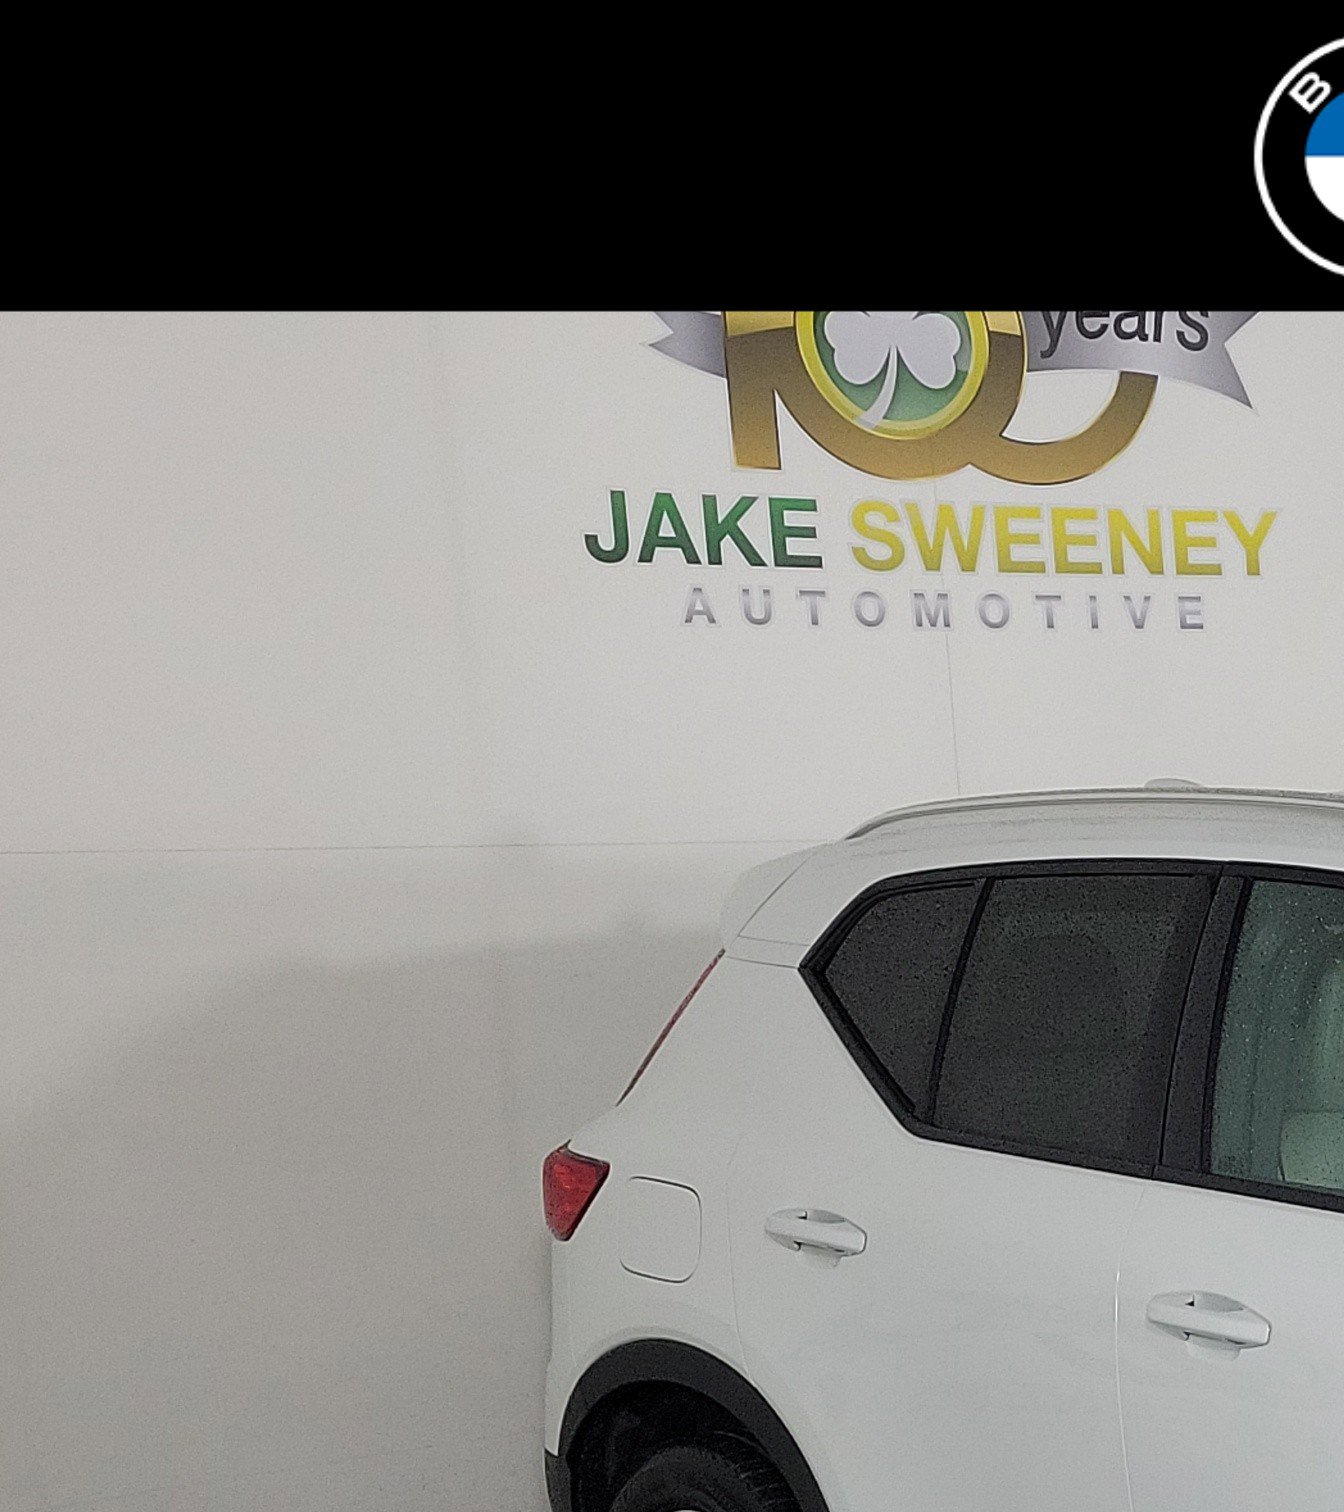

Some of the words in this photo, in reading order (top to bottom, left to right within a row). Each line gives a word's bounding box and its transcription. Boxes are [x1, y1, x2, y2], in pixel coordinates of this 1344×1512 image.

[584, 490, 823, 569] JAKE
[850, 501, 1277, 577] SWEENEY
[684, 587, 1204, 630] AUTOMOTIVE
